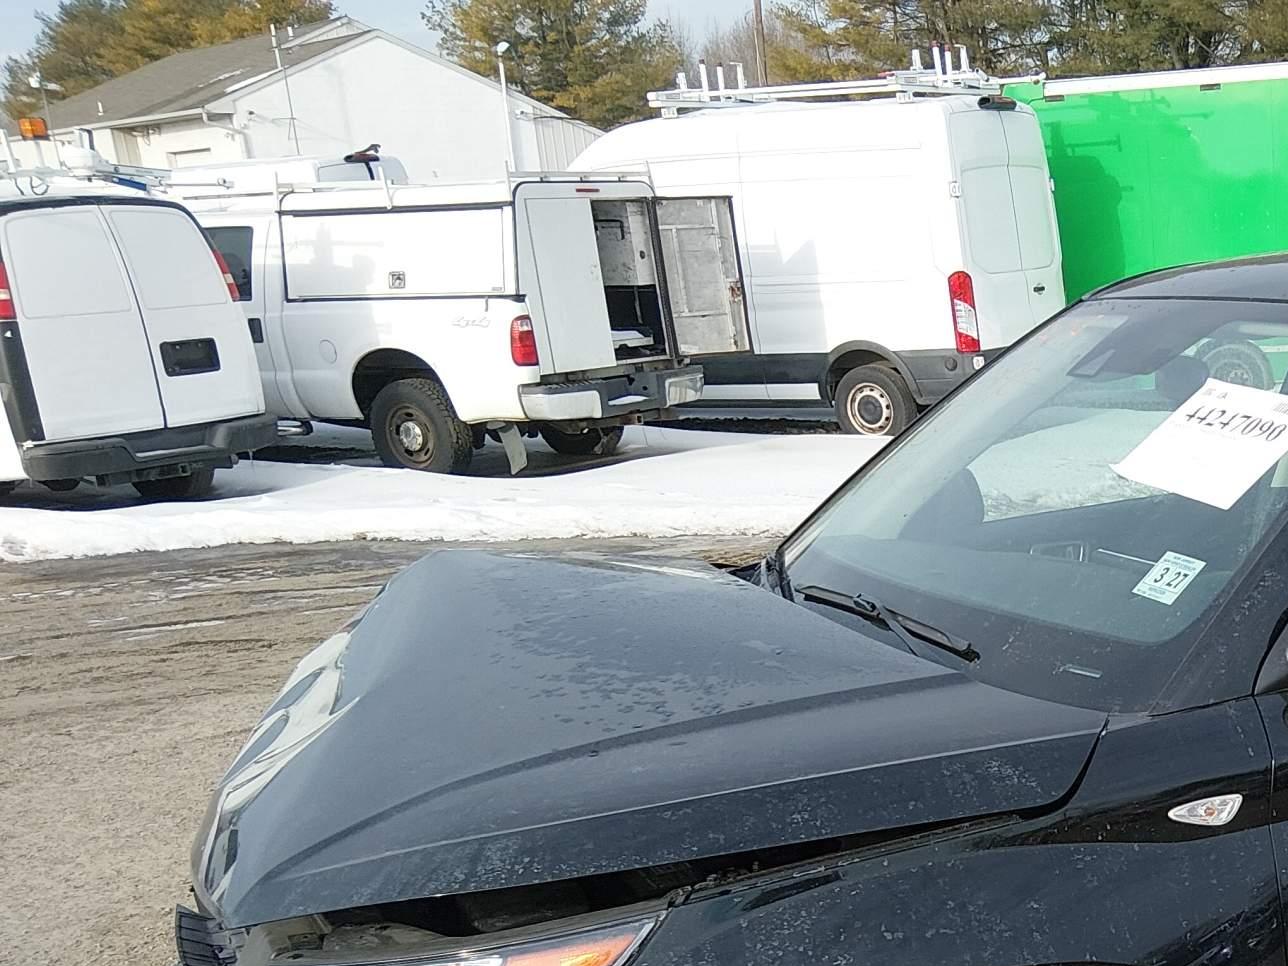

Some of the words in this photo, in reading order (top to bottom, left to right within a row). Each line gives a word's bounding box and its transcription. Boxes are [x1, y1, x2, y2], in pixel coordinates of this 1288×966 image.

[1186, 405, 1288, 442] 44247090
[1153, 567, 1171, 584] 3
[1165, 571, 1190, 589] 27
